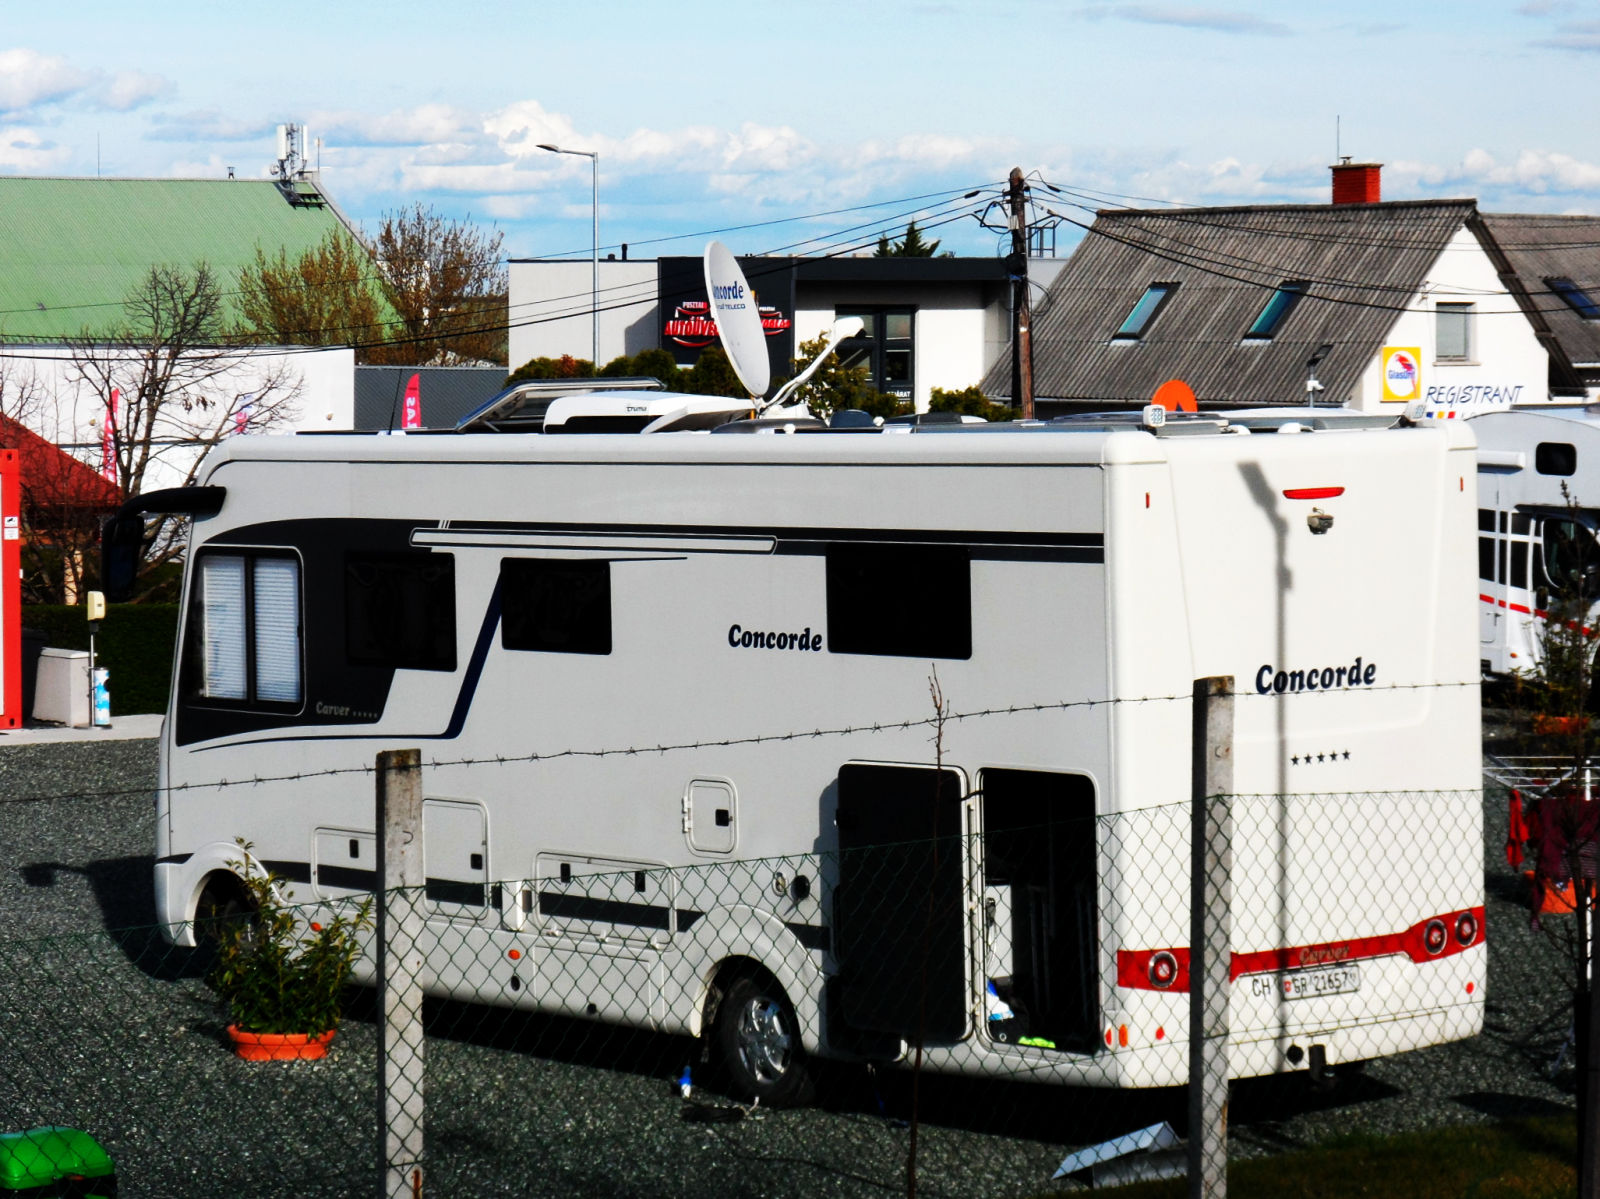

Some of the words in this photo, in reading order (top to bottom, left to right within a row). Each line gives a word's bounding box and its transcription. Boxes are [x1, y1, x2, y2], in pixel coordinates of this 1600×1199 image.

[1425, 385, 1524, 408] REGISTRANT
[728, 624, 822, 652] Concorde
[1255, 656, 1377, 695] Concorde
[316, 701, 350, 716] Carver
[1300, 945, 1350, 963] Carver
[1252, 977, 1272, 997] CH
